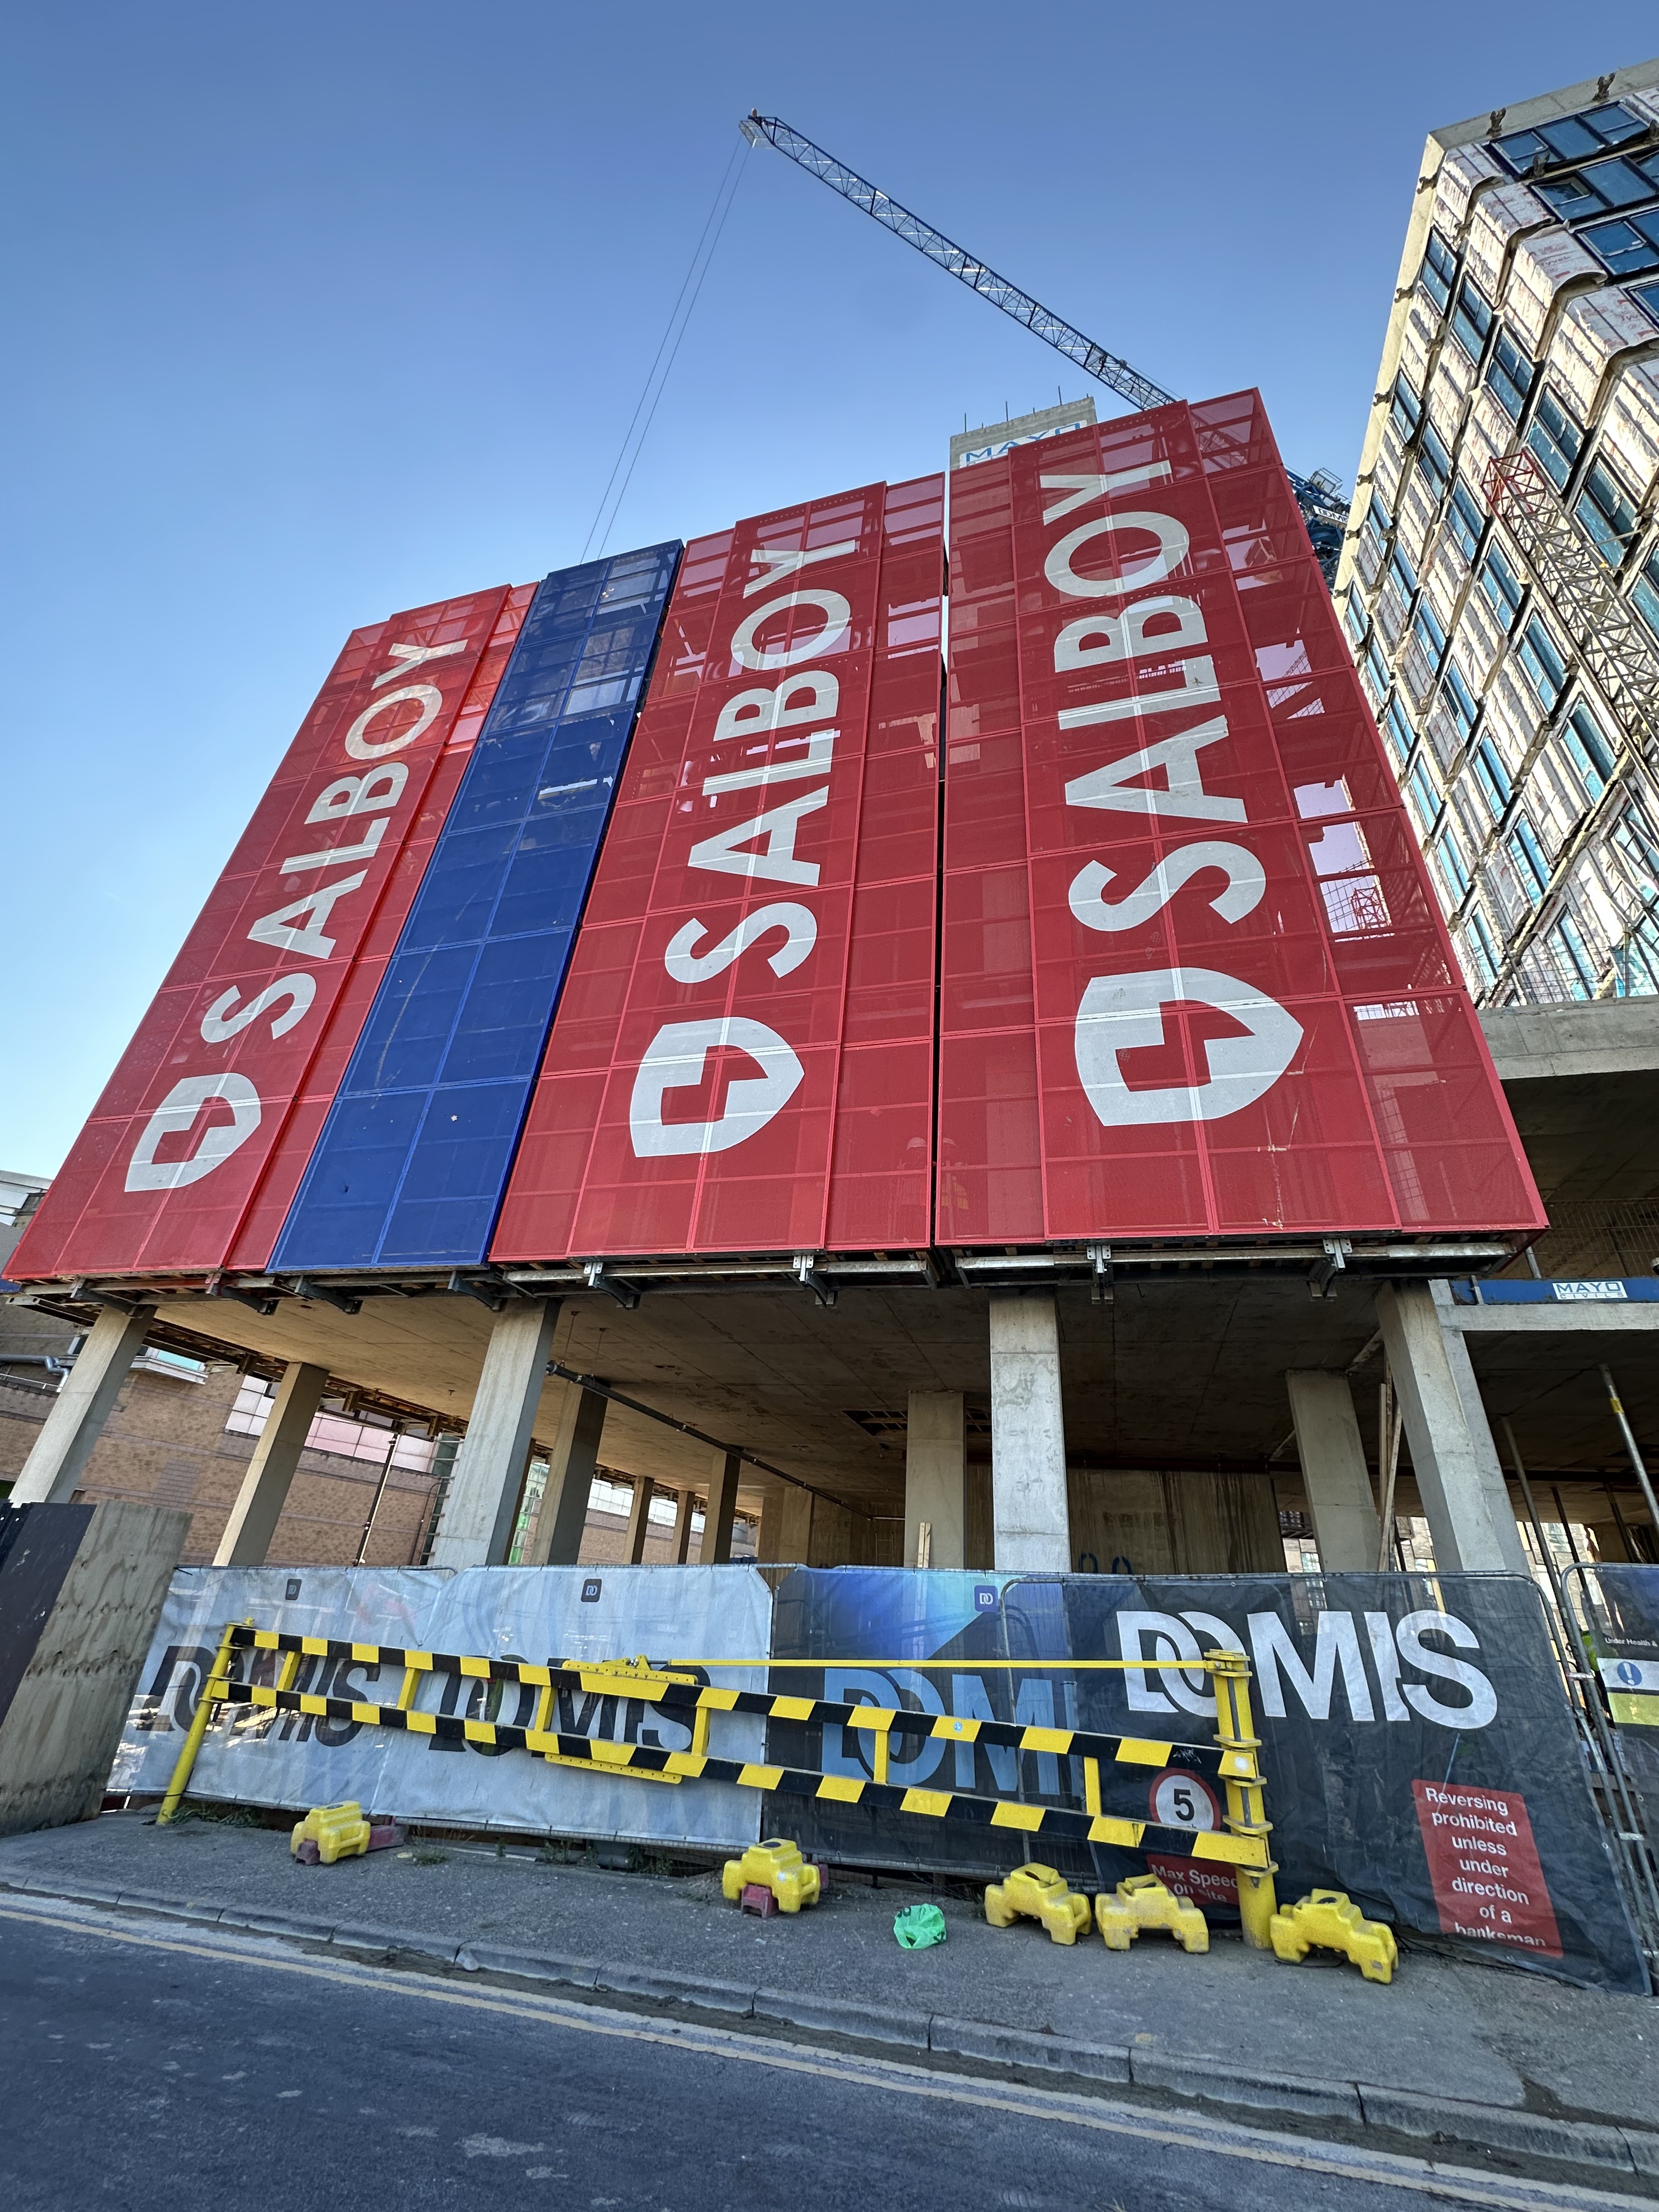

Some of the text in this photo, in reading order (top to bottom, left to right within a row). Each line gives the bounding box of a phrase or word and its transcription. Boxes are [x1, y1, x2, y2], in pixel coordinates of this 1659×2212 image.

[1040, 460, 1267, 932] SALBOY
[664, 539, 856, 984] SALBOY
[200, 639, 468, 1043] SALBOY
[1556, 1282, 1621, 1293] MAYO
[1626, 1638, 1651, 1646] Health
[1116, 1609, 1498, 1729] DOMIS
[1173, 1788, 1195, 1821] 5
[1425, 1787, 1509, 1817] Reversing
[1431, 1812, 1519, 1837] prohibited
[1452, 1836, 1507, 1856] unless
[1151, 1864, 1184, 1880] Max
[1459, 1859, 1509, 1878] under
[1173, 1883, 1194, 1895] on
[1452, 1876, 1530, 1905] direction
[1479, 1904, 1513, 1924] of a
